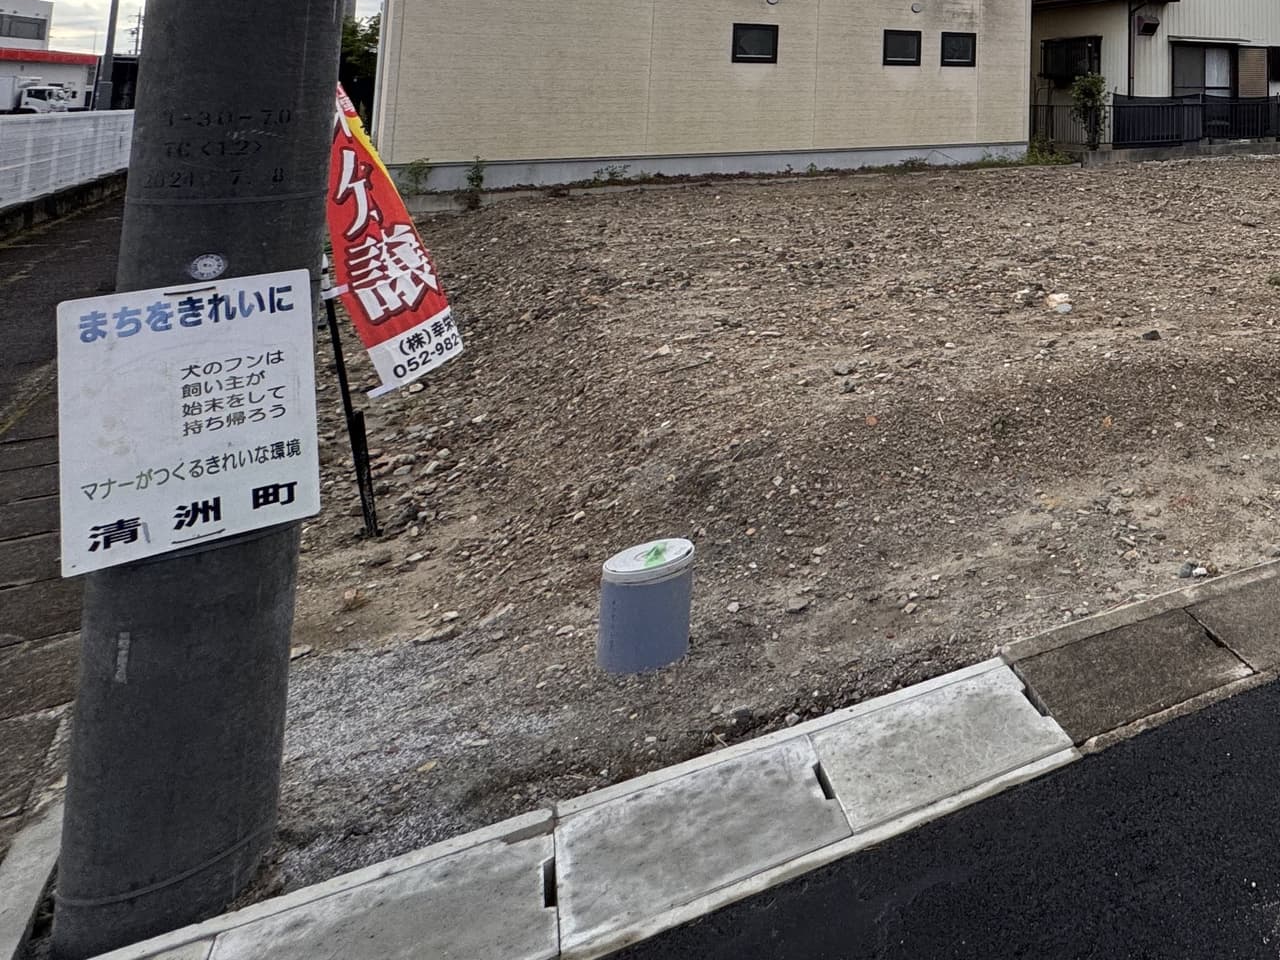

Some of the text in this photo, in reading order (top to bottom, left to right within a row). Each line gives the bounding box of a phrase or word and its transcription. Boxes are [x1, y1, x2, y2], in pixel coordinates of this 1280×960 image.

[79, 286, 294, 343] まちをきれいに
[181, 350, 285, 380] 犬のフンは
[181, 370, 266, 398] 飼い主が
[181, 386, 286, 417] 始末をして
[182, 404, 287, 436] 持ち帰ろう
[80, 438, 302, 501] マナーがつくるきれいな環境
[88, 481, 298, 552] 清洲町
